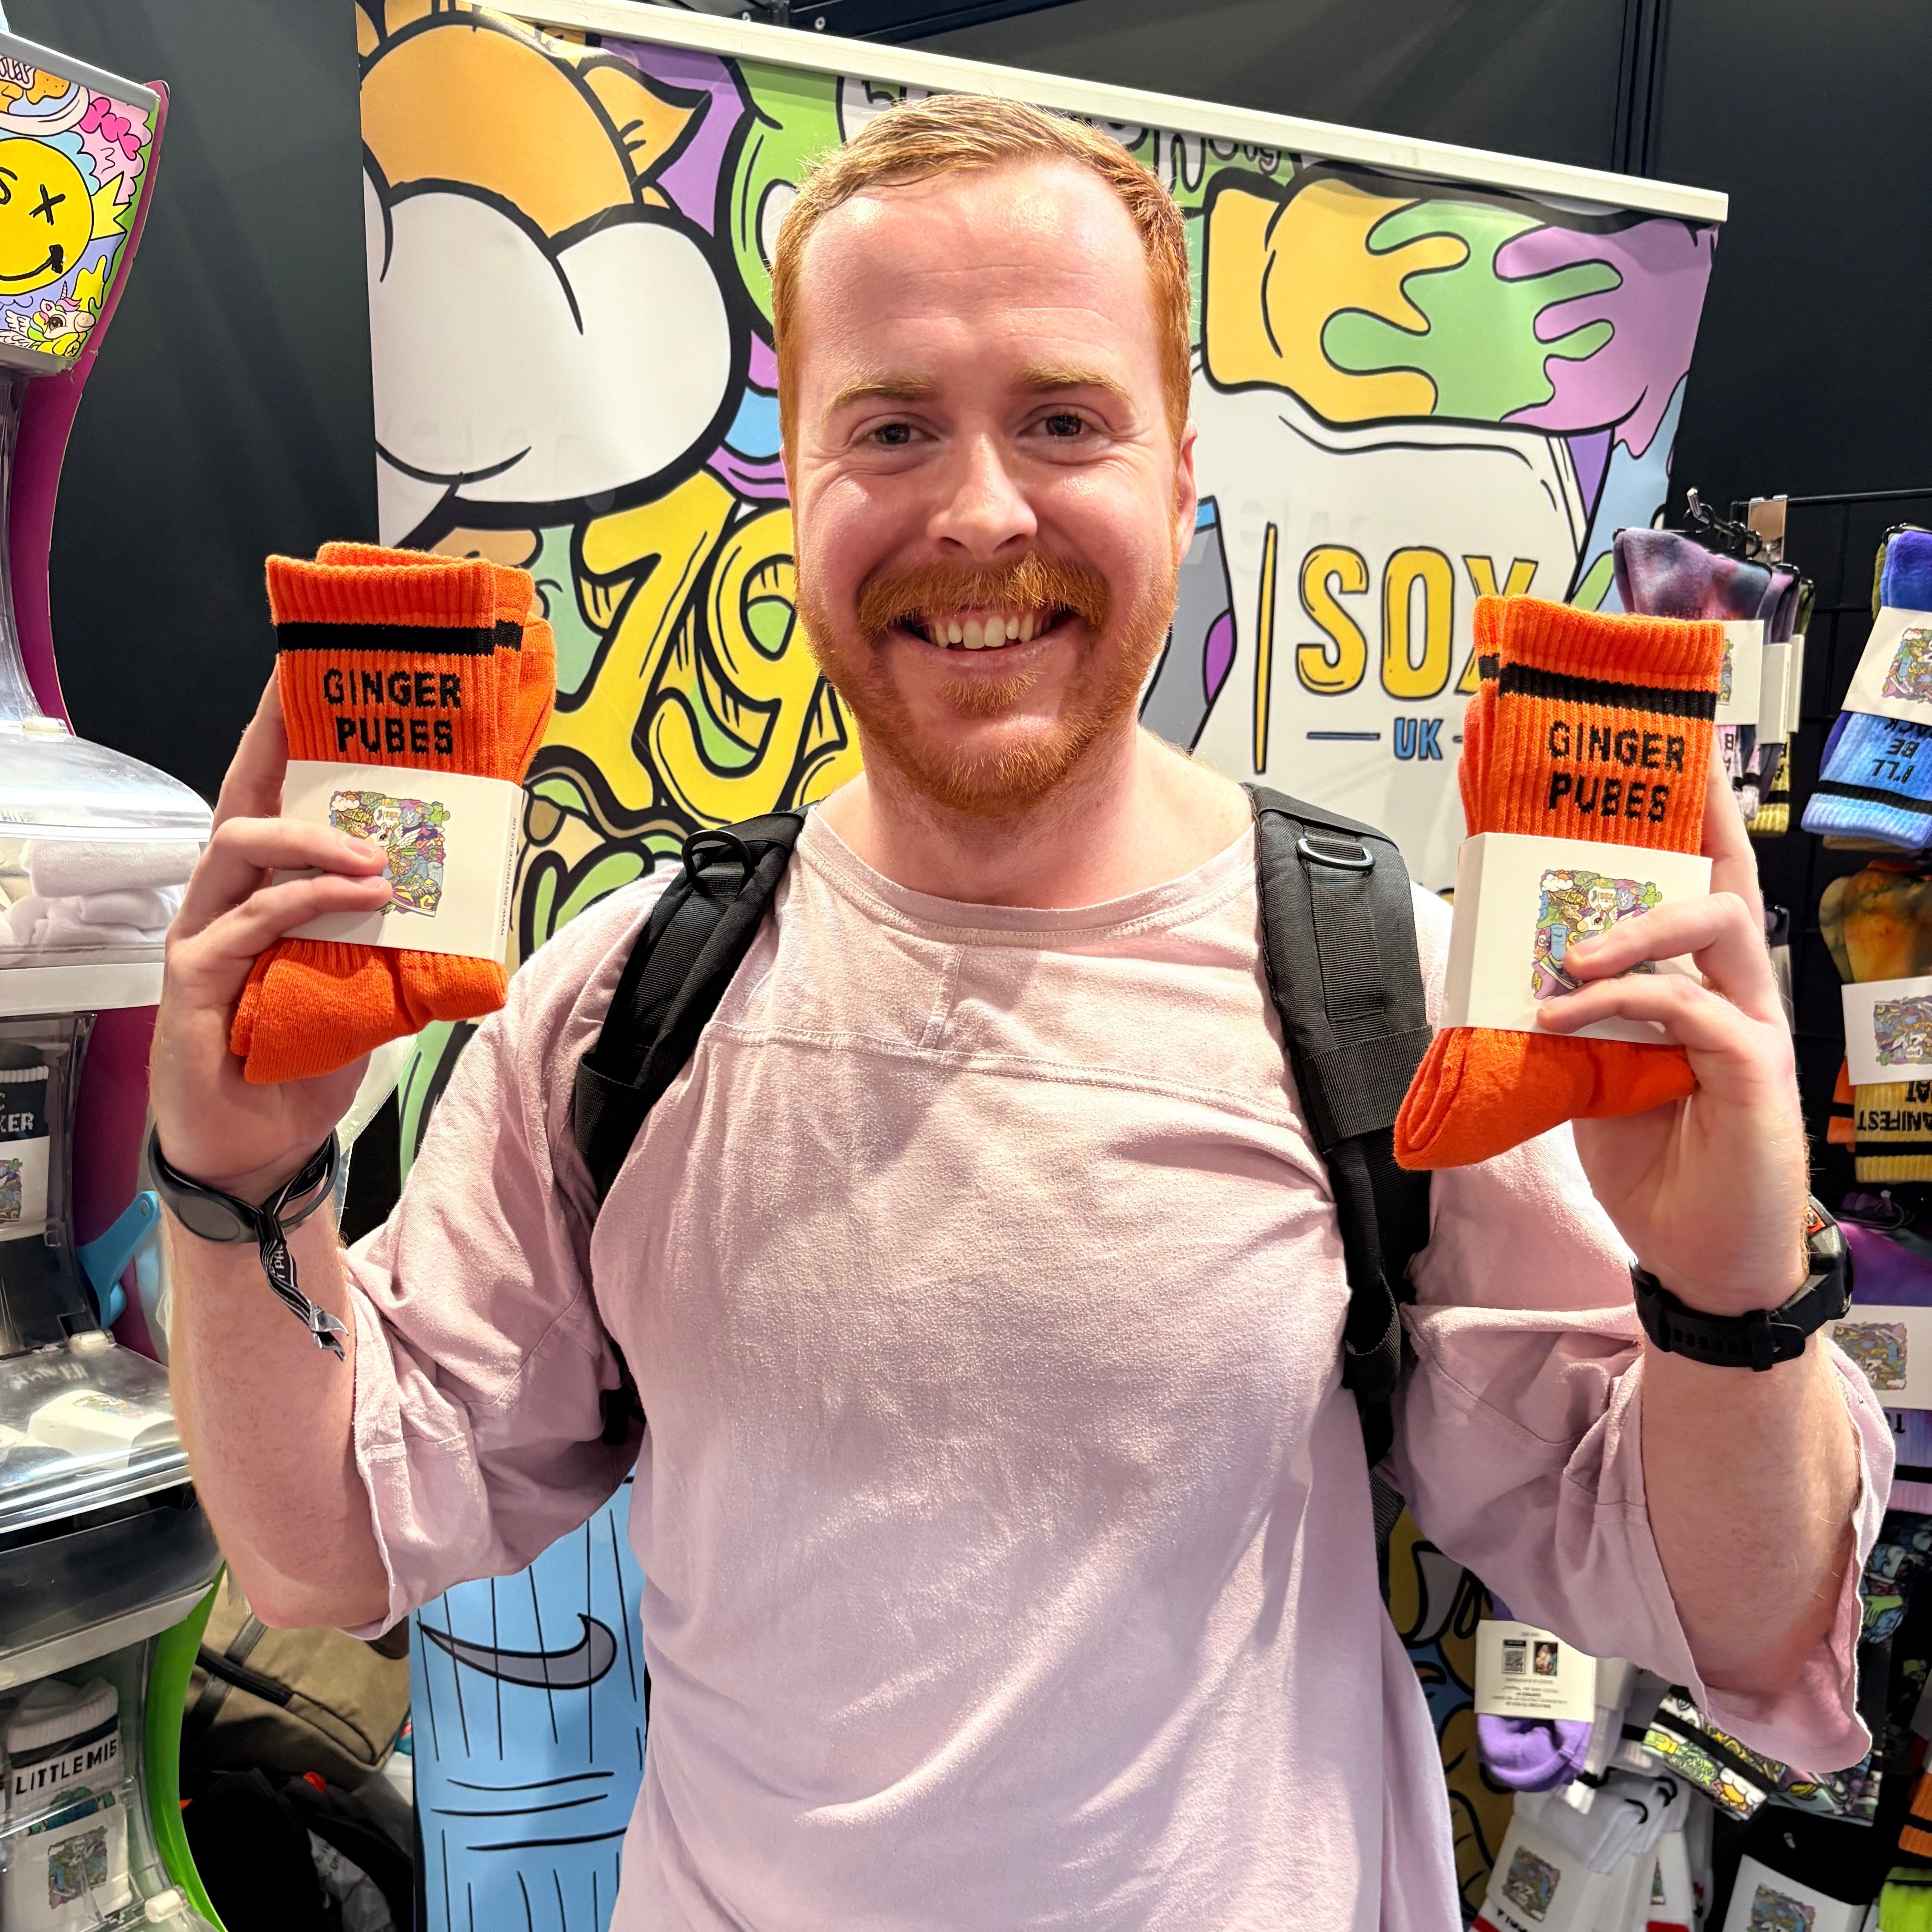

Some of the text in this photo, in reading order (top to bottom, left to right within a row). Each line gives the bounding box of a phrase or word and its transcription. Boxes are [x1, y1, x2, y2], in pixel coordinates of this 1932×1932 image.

[324, 667, 461, 708] GINGER
[336, 716, 453, 755] PUBES
[1393, 717, 1444, 761] UK
[1549, 721, 1685, 773] GINGER
[1884, 718, 1932, 740] ACK
[1885, 739, 1920, 759] BE
[1872, 759, 1915, 784] I'LL
[1548, 771, 1669, 823] PUBES
